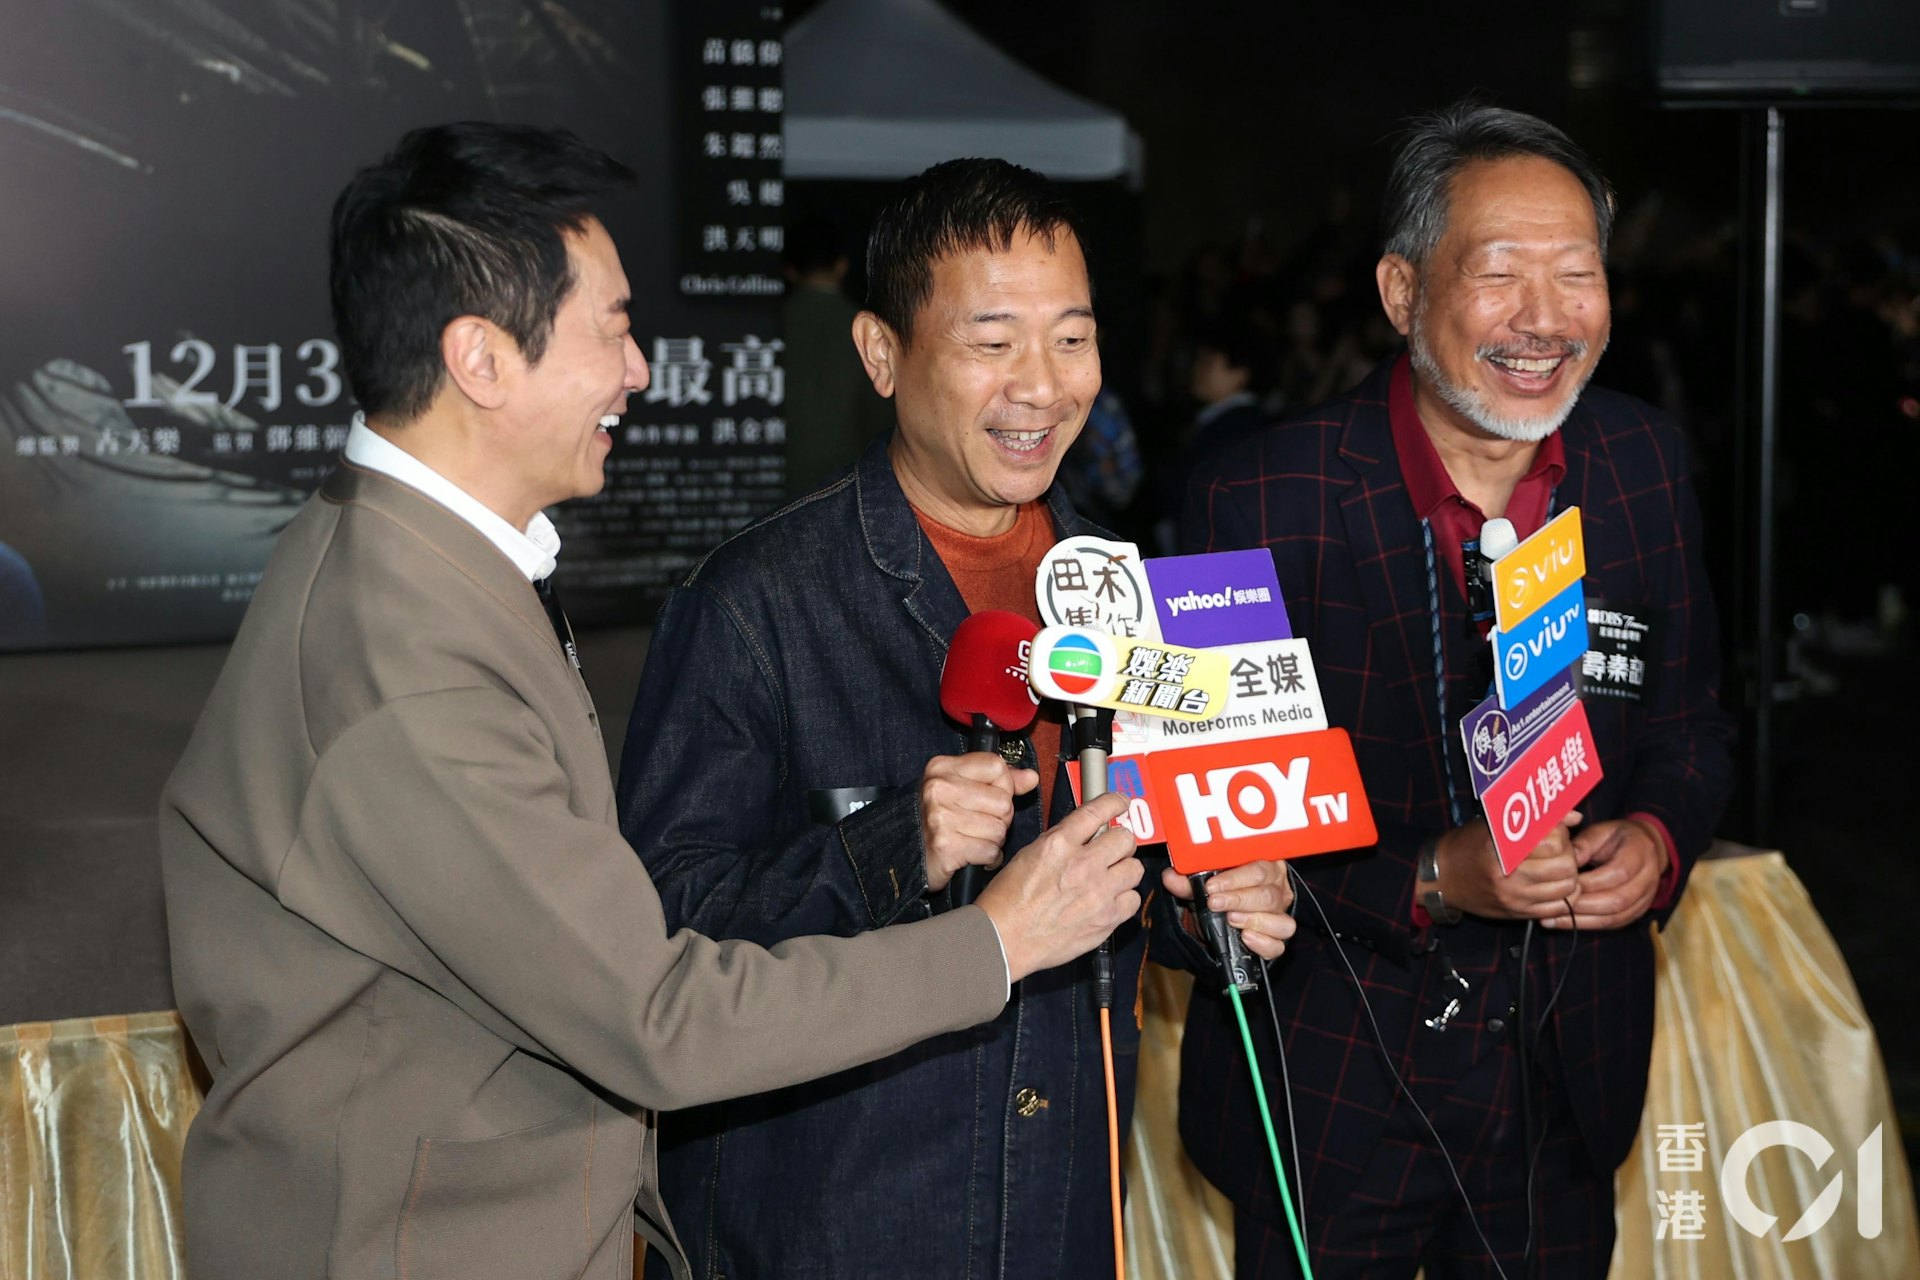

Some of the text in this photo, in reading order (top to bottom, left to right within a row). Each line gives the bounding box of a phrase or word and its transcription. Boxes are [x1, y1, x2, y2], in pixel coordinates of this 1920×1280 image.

[644, 335, 786, 407] 最高
[1533, 539, 1574, 583] viu
[1166, 587, 1232, 617] yahoo!
[1118, 679, 1209, 715] 新聞台
[1230, 653, 1305, 698] 全媒
[1162, 704, 1313, 736] MoreForms Media
[1175, 756, 1310, 844] HOY
[1309, 792, 1348, 826] TV
